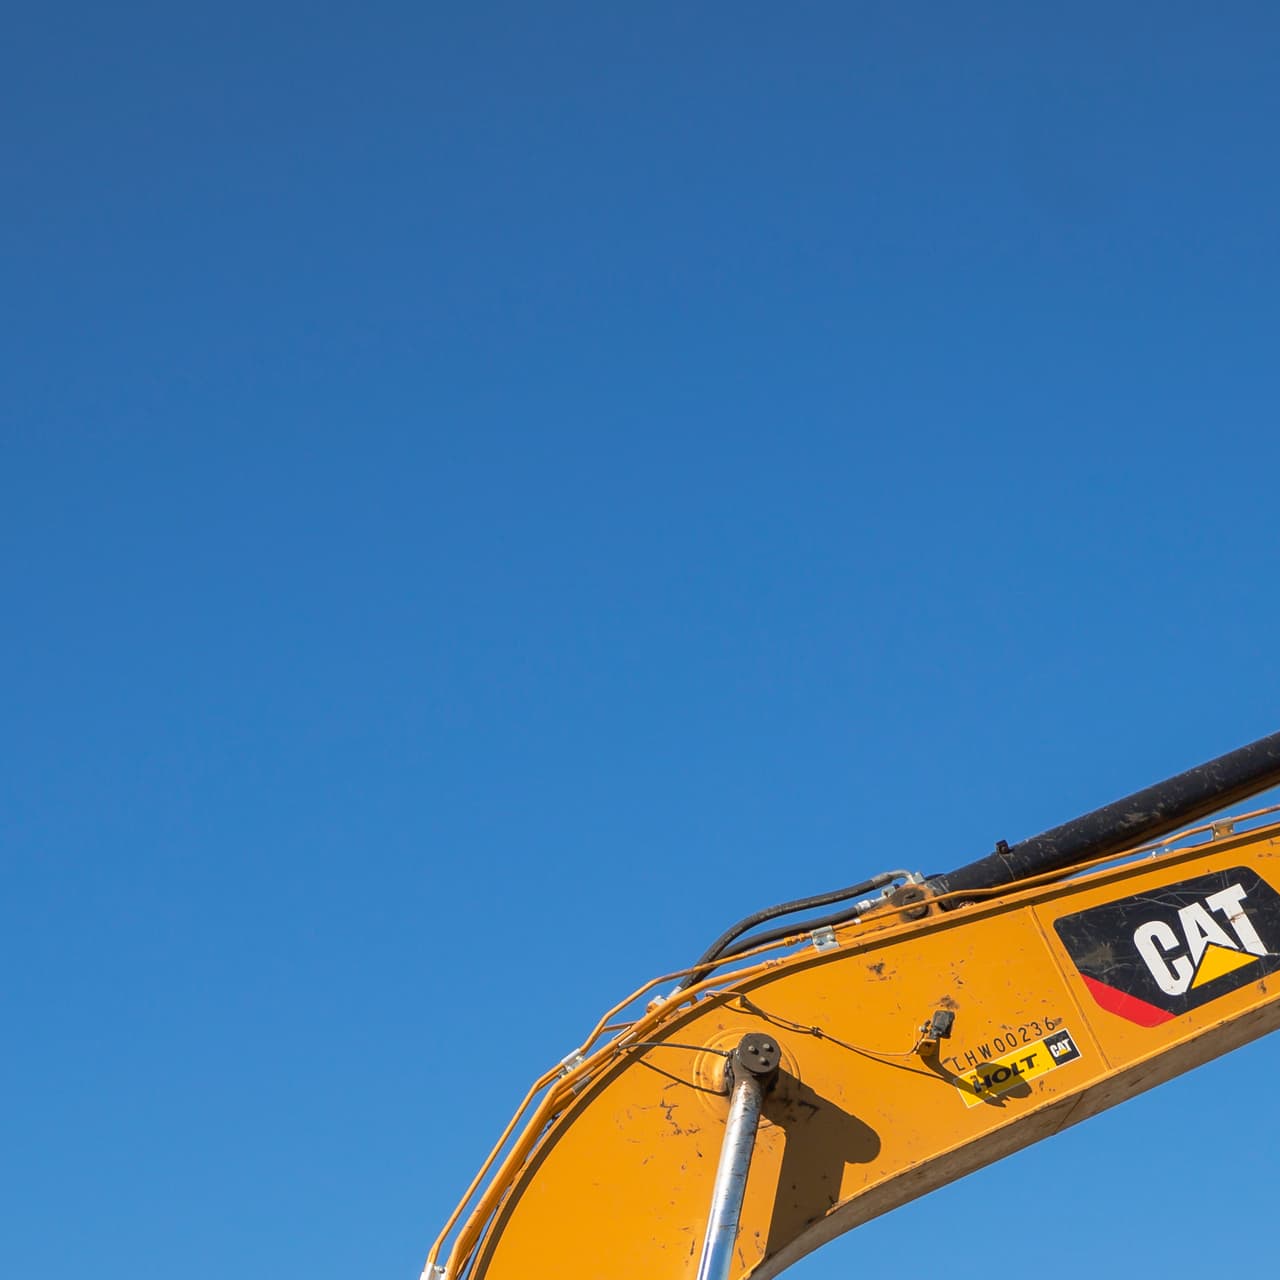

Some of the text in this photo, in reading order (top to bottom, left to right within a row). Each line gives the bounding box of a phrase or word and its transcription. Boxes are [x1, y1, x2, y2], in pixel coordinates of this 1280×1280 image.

[1133, 884, 1267, 996] CAT
[952, 1017, 1056, 1071] LHW00236
[973, 1038, 1073, 1093] HOLT CAT
